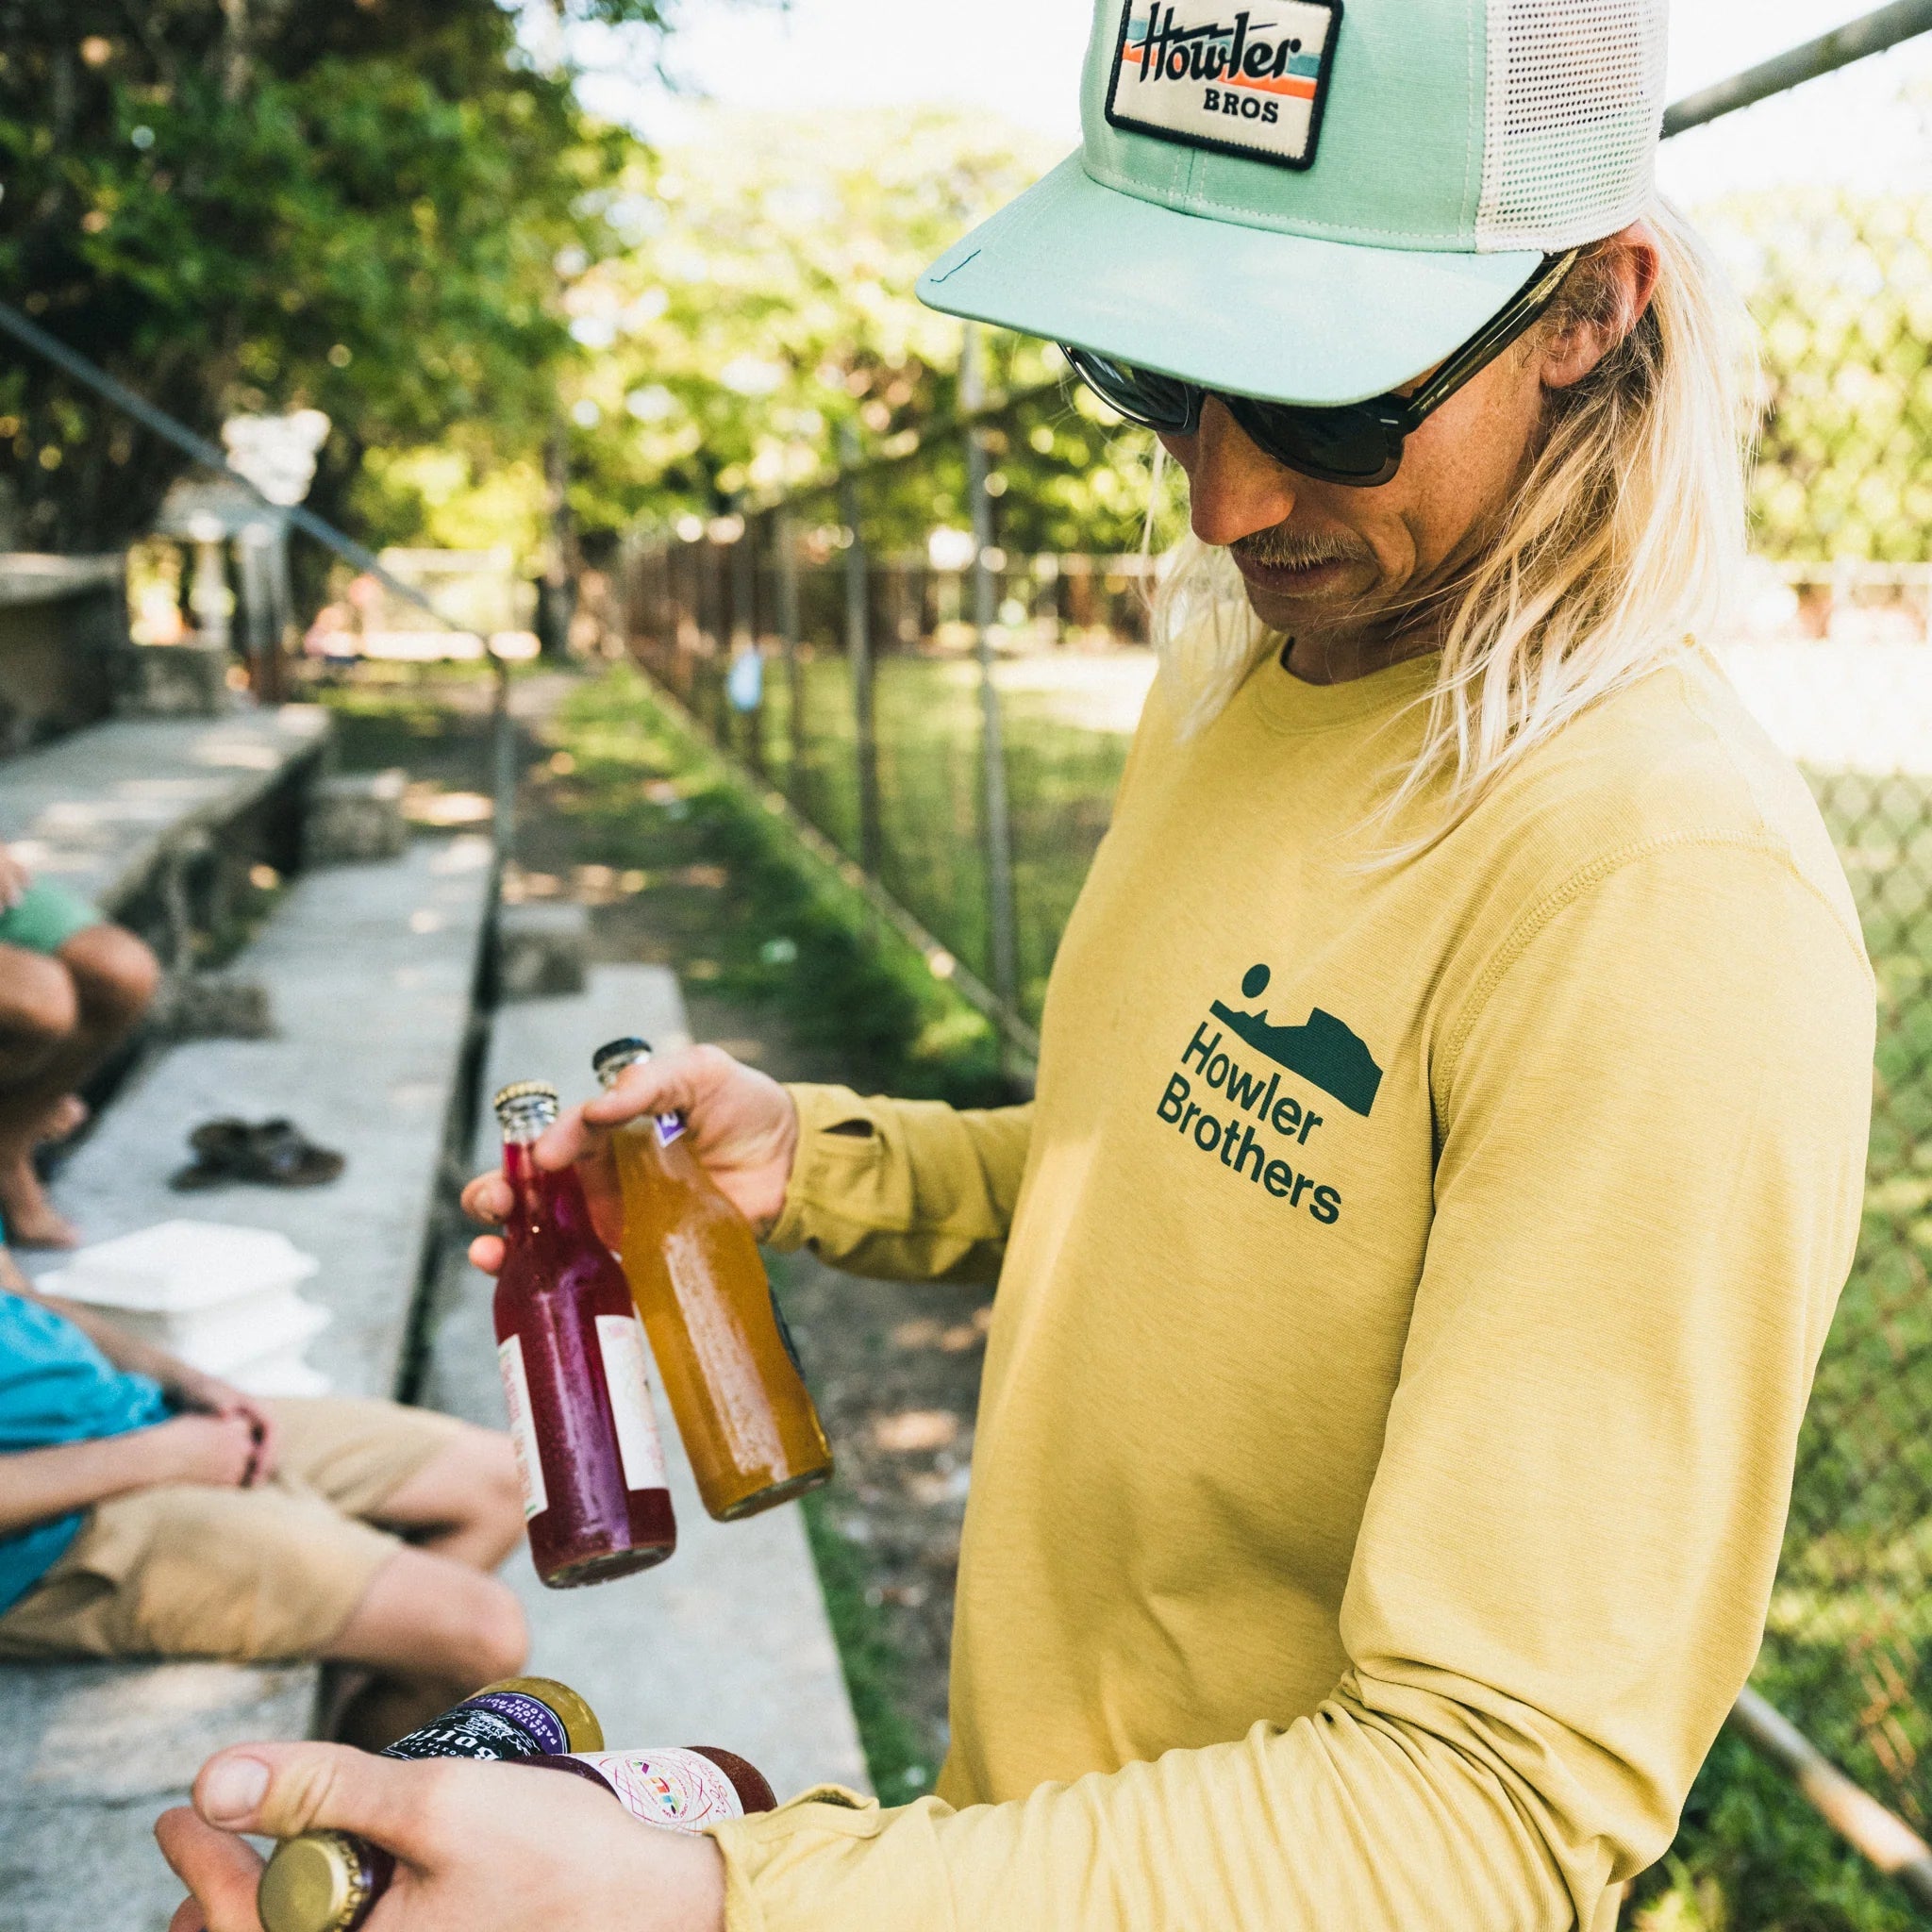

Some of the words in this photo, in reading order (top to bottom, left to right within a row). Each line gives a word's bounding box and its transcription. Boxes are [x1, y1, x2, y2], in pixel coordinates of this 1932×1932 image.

[1131, 2, 1302, 83] Howler
[1204, 88, 1278, 124] BROS
[1181, 1021, 1324, 1146] Howler
[1157, 1072, 1341, 1224] Brothers
[491, 1702, 543, 1736] NATURAL
[515, 1699, 545, 1720] SODA
